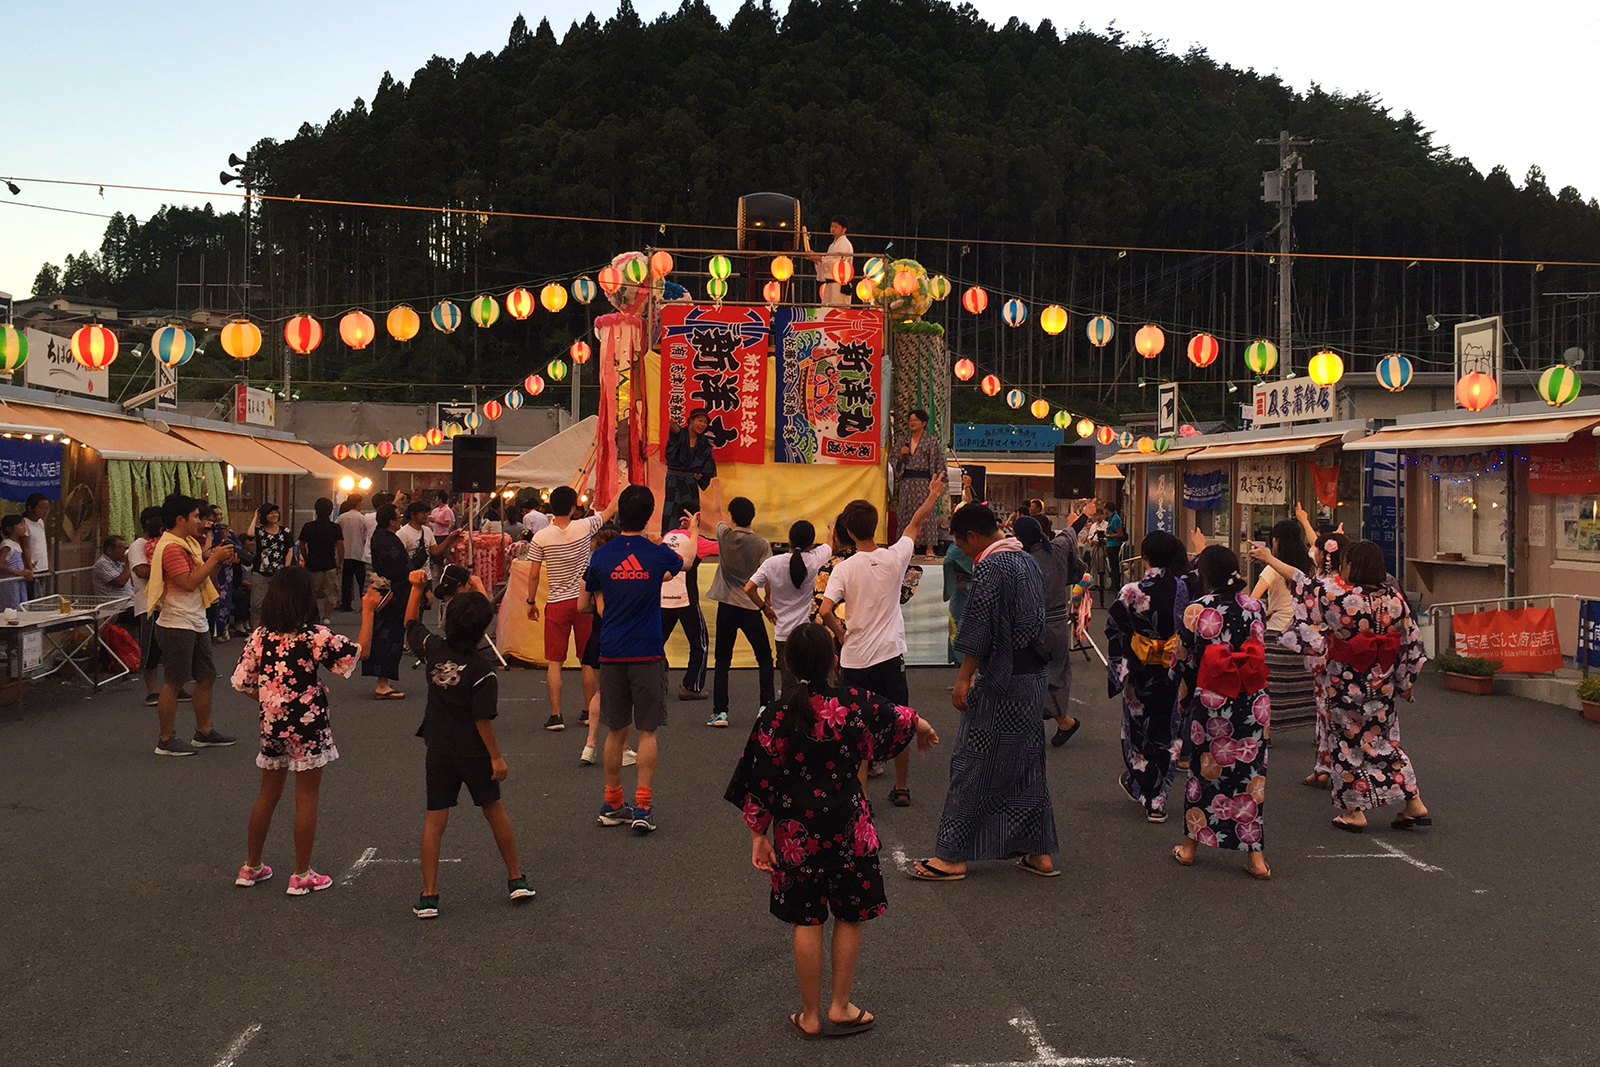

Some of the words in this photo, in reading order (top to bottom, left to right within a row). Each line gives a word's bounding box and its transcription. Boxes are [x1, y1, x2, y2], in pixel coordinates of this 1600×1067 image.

[742, 352, 761, 393] 祈大漁
[836, 340, 877, 438] 新洋丸
[740, 395, 760, 448] 海上安全
[610, 570, 650, 580] adidas
